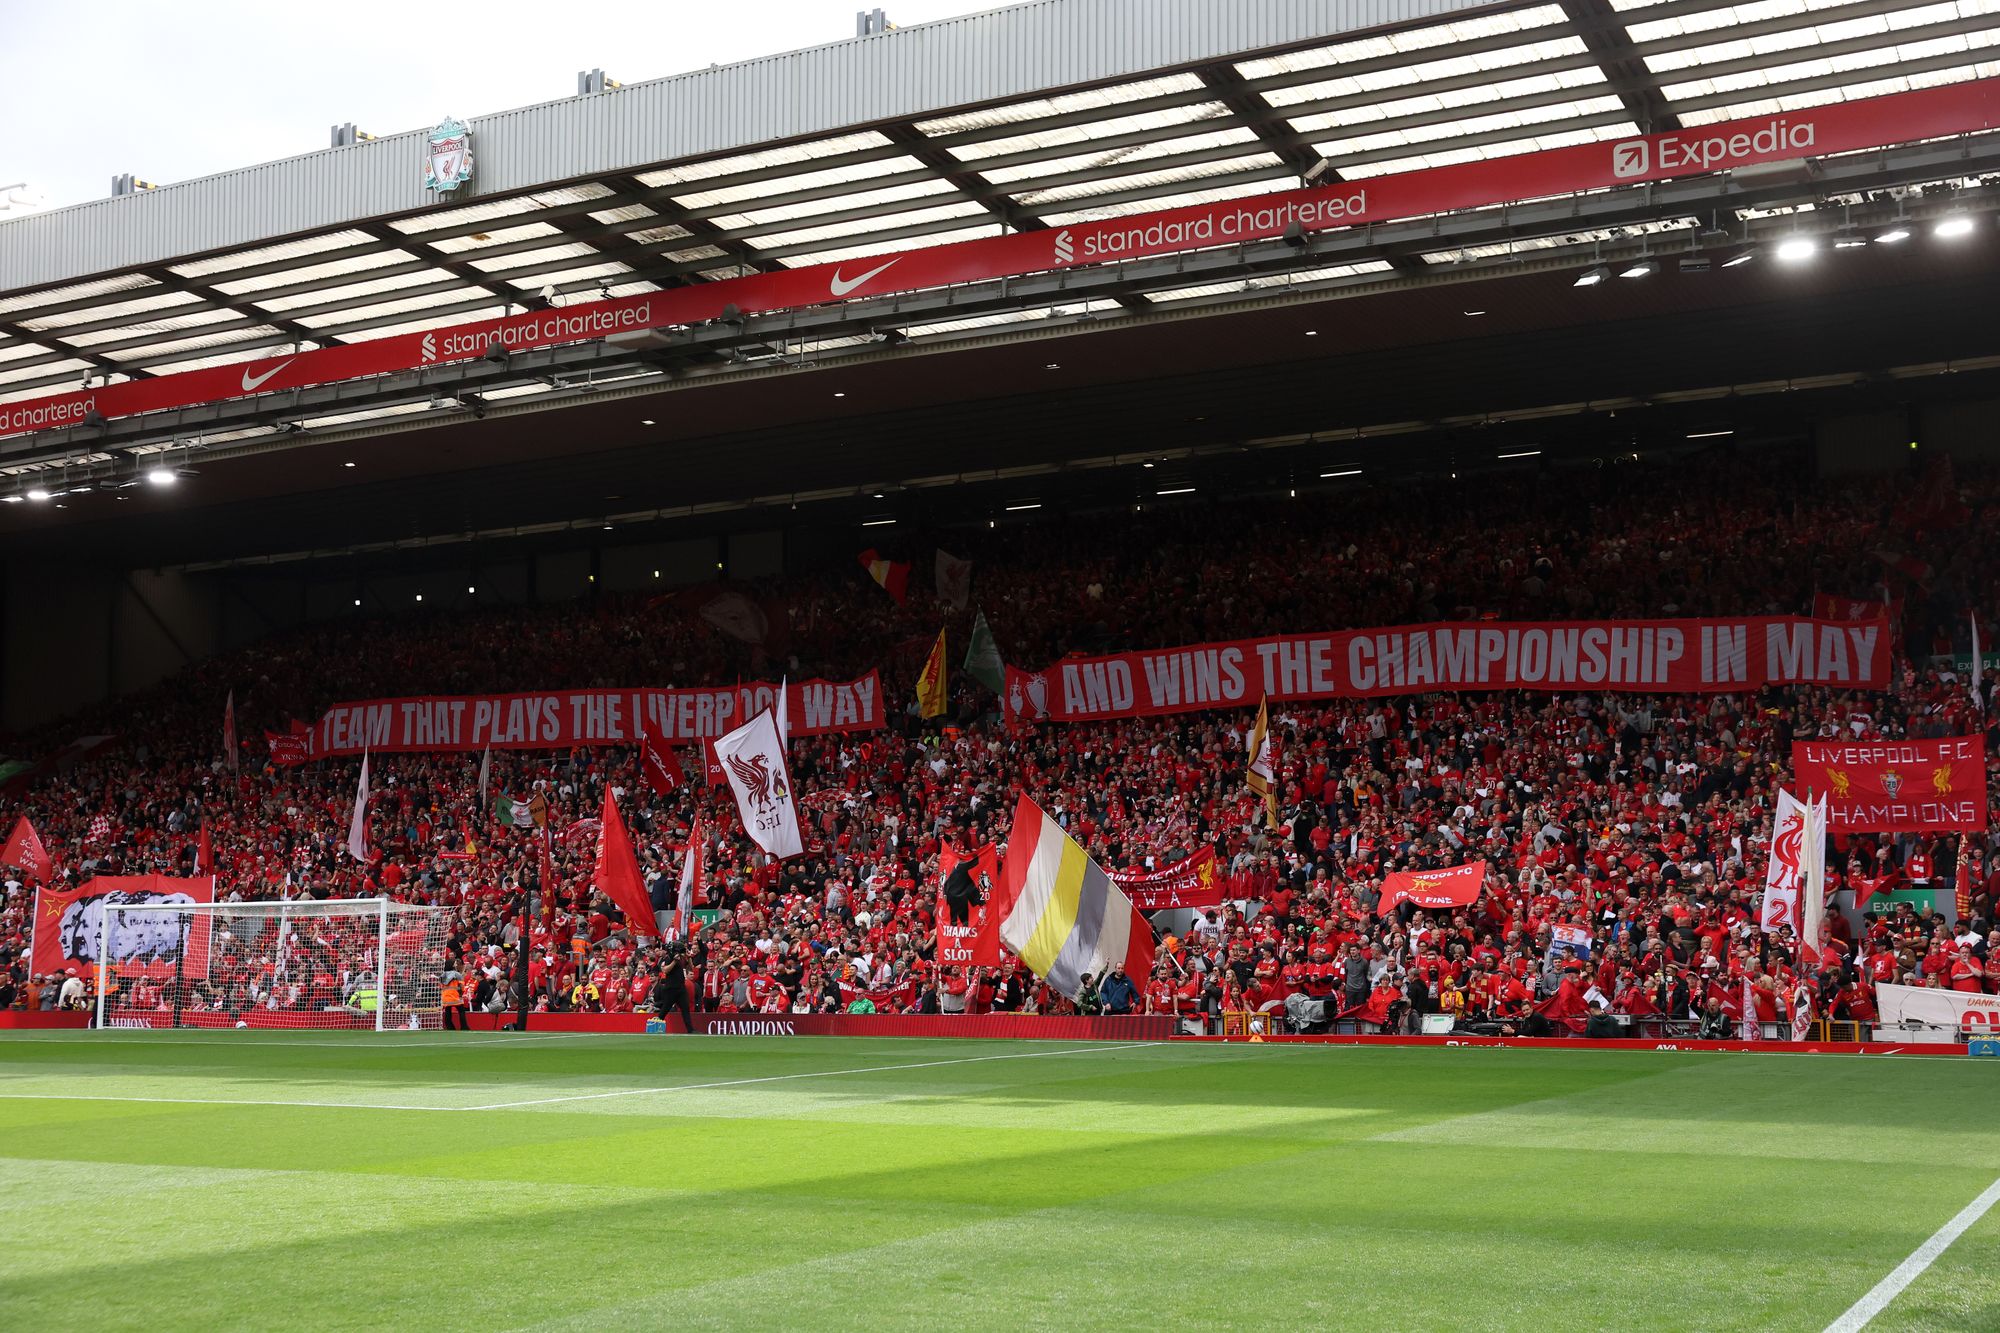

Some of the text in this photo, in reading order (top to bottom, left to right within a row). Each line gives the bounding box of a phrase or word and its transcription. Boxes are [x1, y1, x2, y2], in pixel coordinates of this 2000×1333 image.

[433, 141, 463, 155] LIVERPOOL
[1659, 119, 1815, 169] Expedia
[1084, 189, 1366, 256] standard chartered
[443, 301, 651, 356] standard chartered
[13, 396, 95, 428] chartered
[1062, 621, 1879, 715] AND WINS THE CHAMPIONSHIP IN MAY
[1957, 661, 1974, 671] EXI
[322, 703, 393, 752] TEAM
[401, 700, 466, 745] THAT
[472, 696, 561, 743] PLAYS
[569, 693, 625, 740] THE
[802, 676, 875, 729] WAY
[1806, 742, 1973, 765] LIVERPOOL F.C.
[710, 764, 721, 773] 20
[1823, 801, 1976, 824] HAMPIONS
[20, 857, 38, 871] WAR
[1457, 867, 1473, 876] FC
[1134, 872, 1198, 893] BROTHER
[980, 891, 990, 901] 20
[1425, 896, 1453, 905] FINE
[942, 925, 978, 938] THANKS
[954, 938, 962, 949] A
[943, 949, 974, 961] SLOT
[708, 1020, 795, 1036] CHAMPIONS
